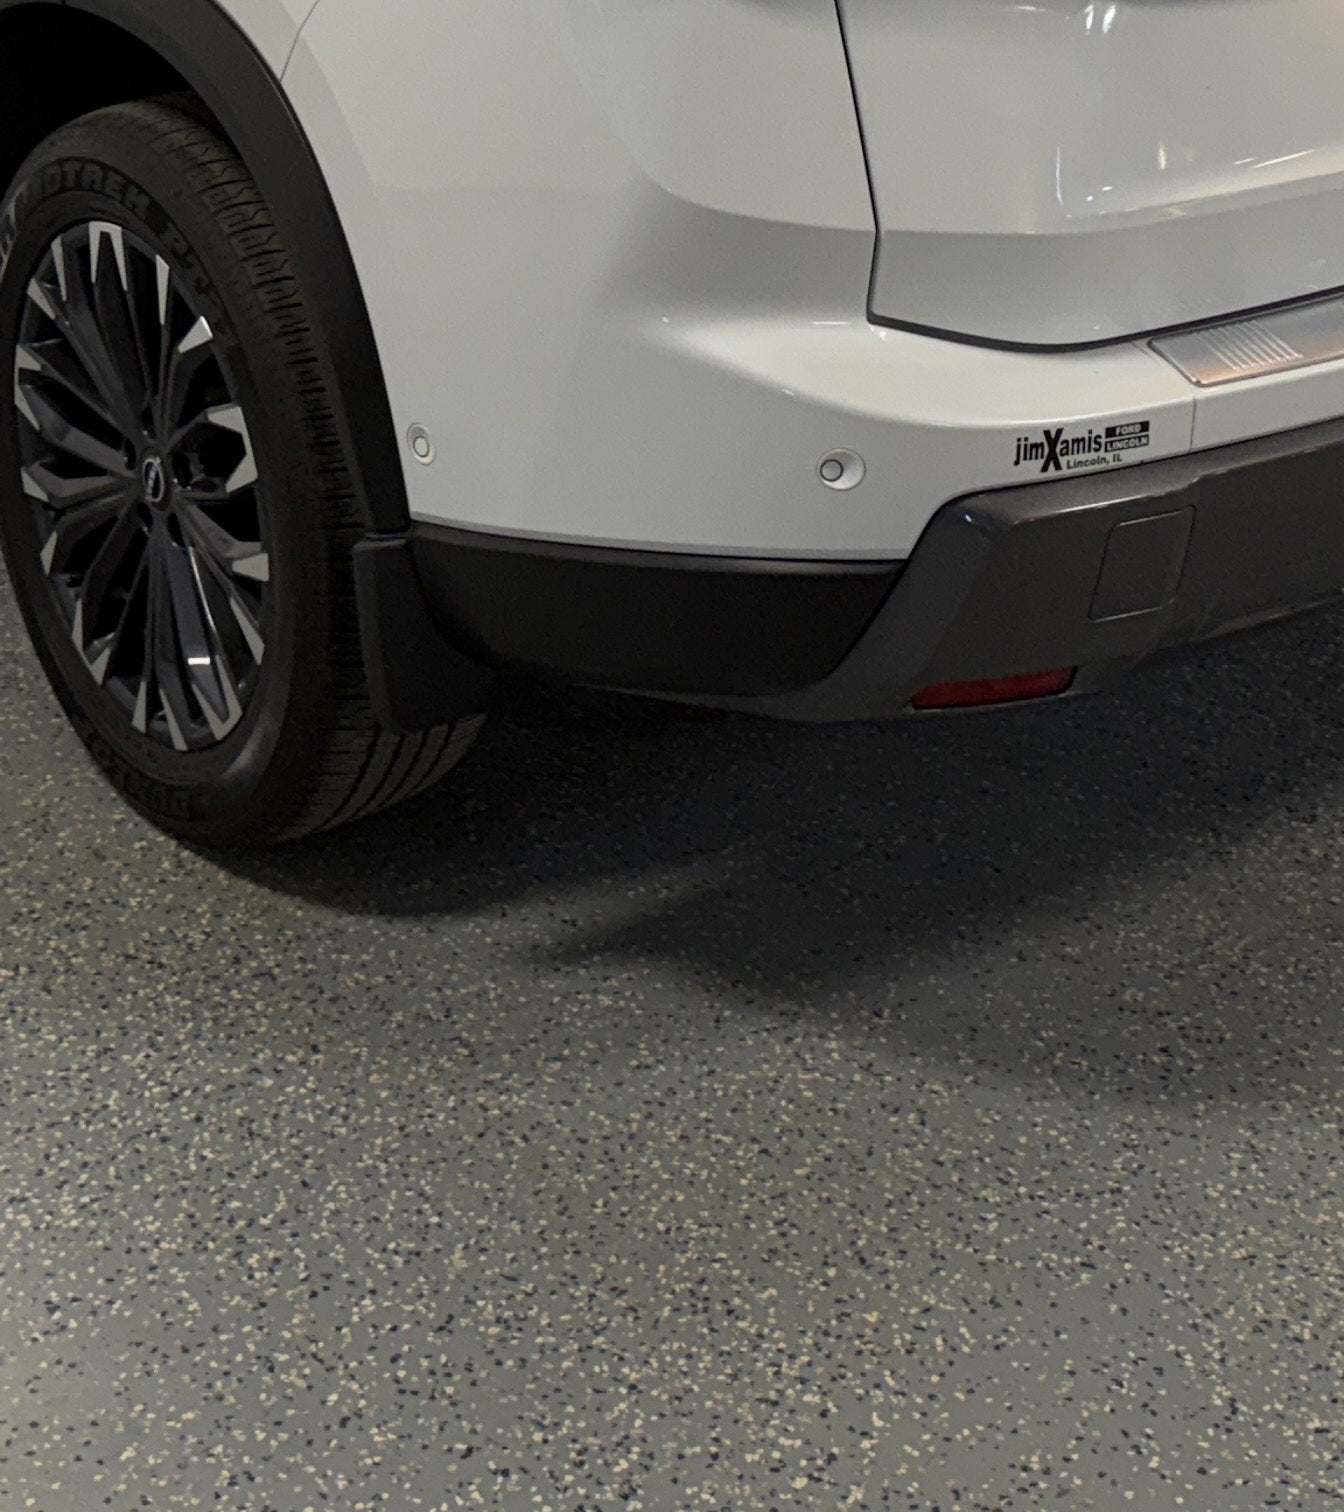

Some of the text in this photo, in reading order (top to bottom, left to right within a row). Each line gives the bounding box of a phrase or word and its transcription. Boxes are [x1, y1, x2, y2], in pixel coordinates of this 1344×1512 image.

[1115, 423, 1141, 436] FORD
[1106, 437, 1148, 451] LINCOLN
[1066, 453, 1123, 470] Lincoln, IL
